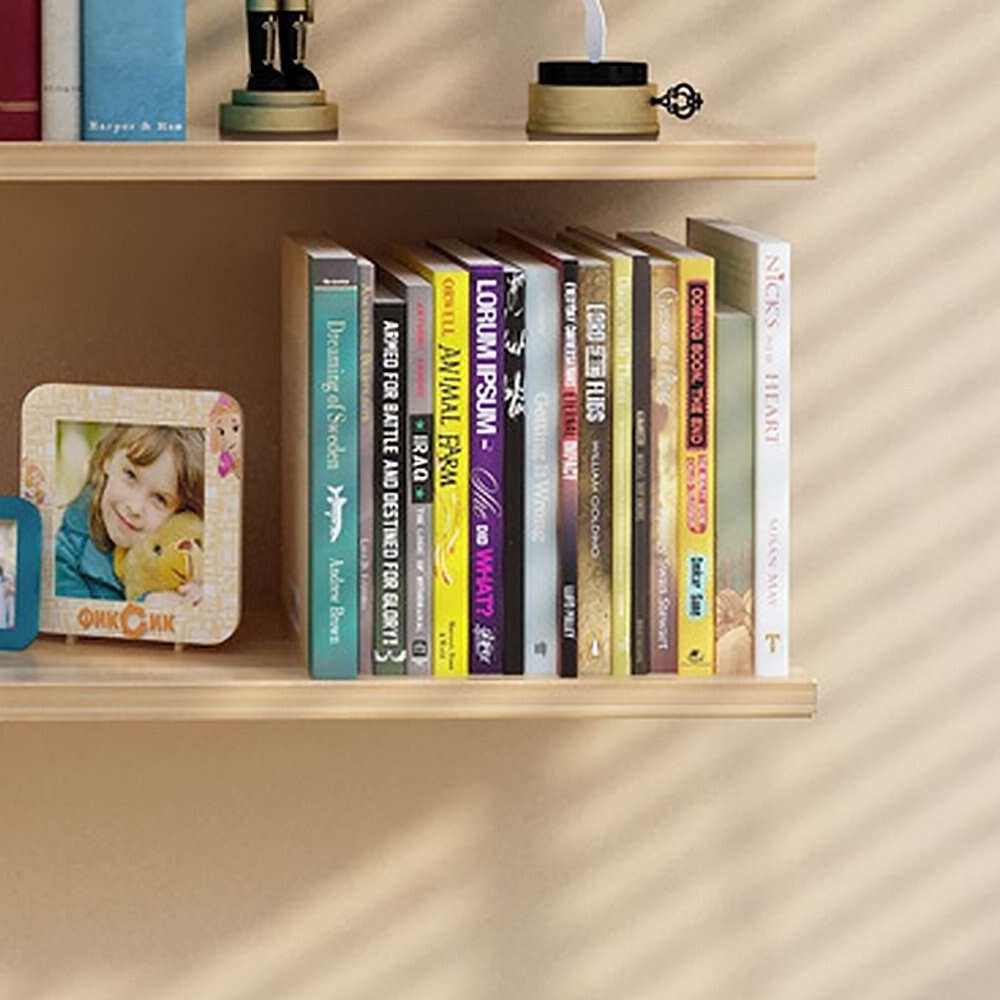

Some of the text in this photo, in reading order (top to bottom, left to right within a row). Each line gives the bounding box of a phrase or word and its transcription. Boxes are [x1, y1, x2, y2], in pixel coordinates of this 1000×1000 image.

[88, 121, 136, 134] Harper
[475, 279, 497, 359] LORUM
[690, 287, 704, 340] COMING
[322, 319, 346, 470] Dreaming of Sweden
[438, 277, 463, 488] ORWELL ANIMAL FARM
[475, 363, 497, 434] IPSUM
[585, 380, 607, 424] FLIES
[690, 387, 704, 414] THE
[764, 373, 780, 446] HEART
[412, 434, 429, 482] IRAQ
[690, 416, 704, 445] END
[382, 320, 399, 645] ARMED FOR BATTLE AND DESTINED FOR GLORY!
[470, 467, 502, 522] She
[590, 439, 601, 559] WILLIAM GOLDING
[476, 524, 489, 546] DID
[328, 557, 345, 644] Andrew Brown
[475, 548, 495, 617] WHAT?
